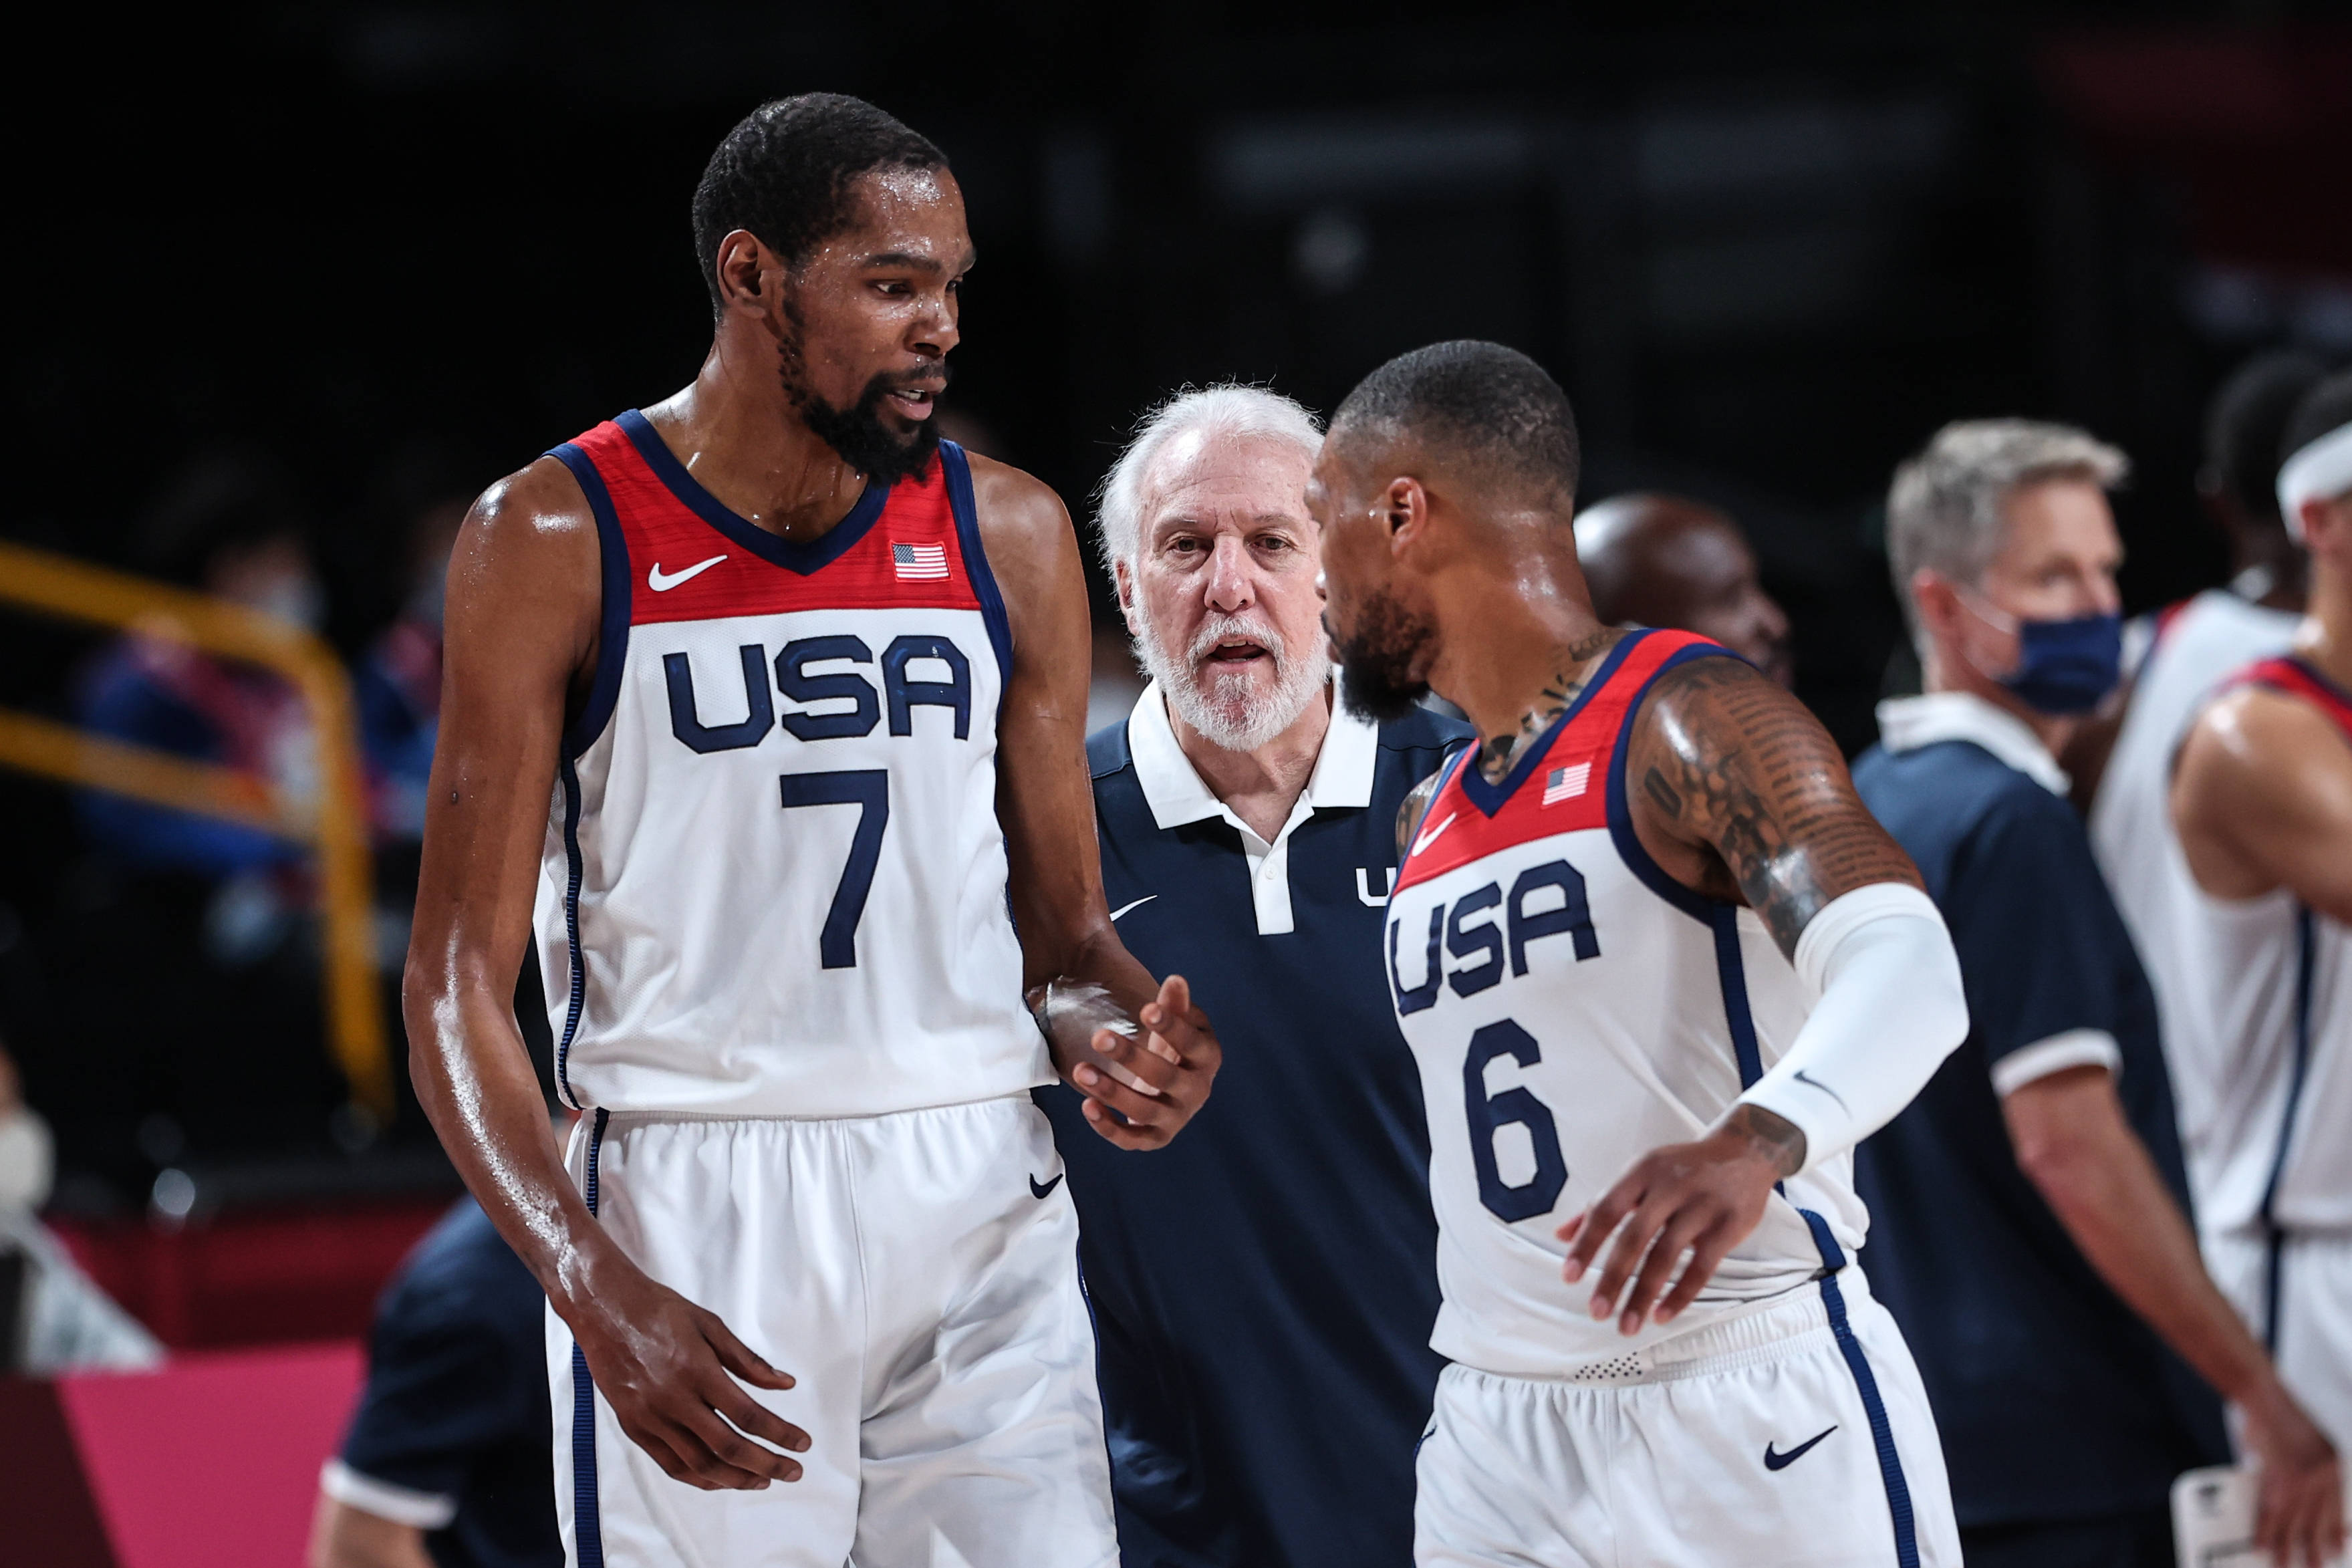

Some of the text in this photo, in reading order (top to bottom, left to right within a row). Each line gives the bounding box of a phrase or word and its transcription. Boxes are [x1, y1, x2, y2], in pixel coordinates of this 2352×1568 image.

[663, 634, 971, 754] USA
[779, 769, 889, 969] 7
[1390, 859, 1601, 1017] USA
[1463, 1017, 1569, 1224] 6
